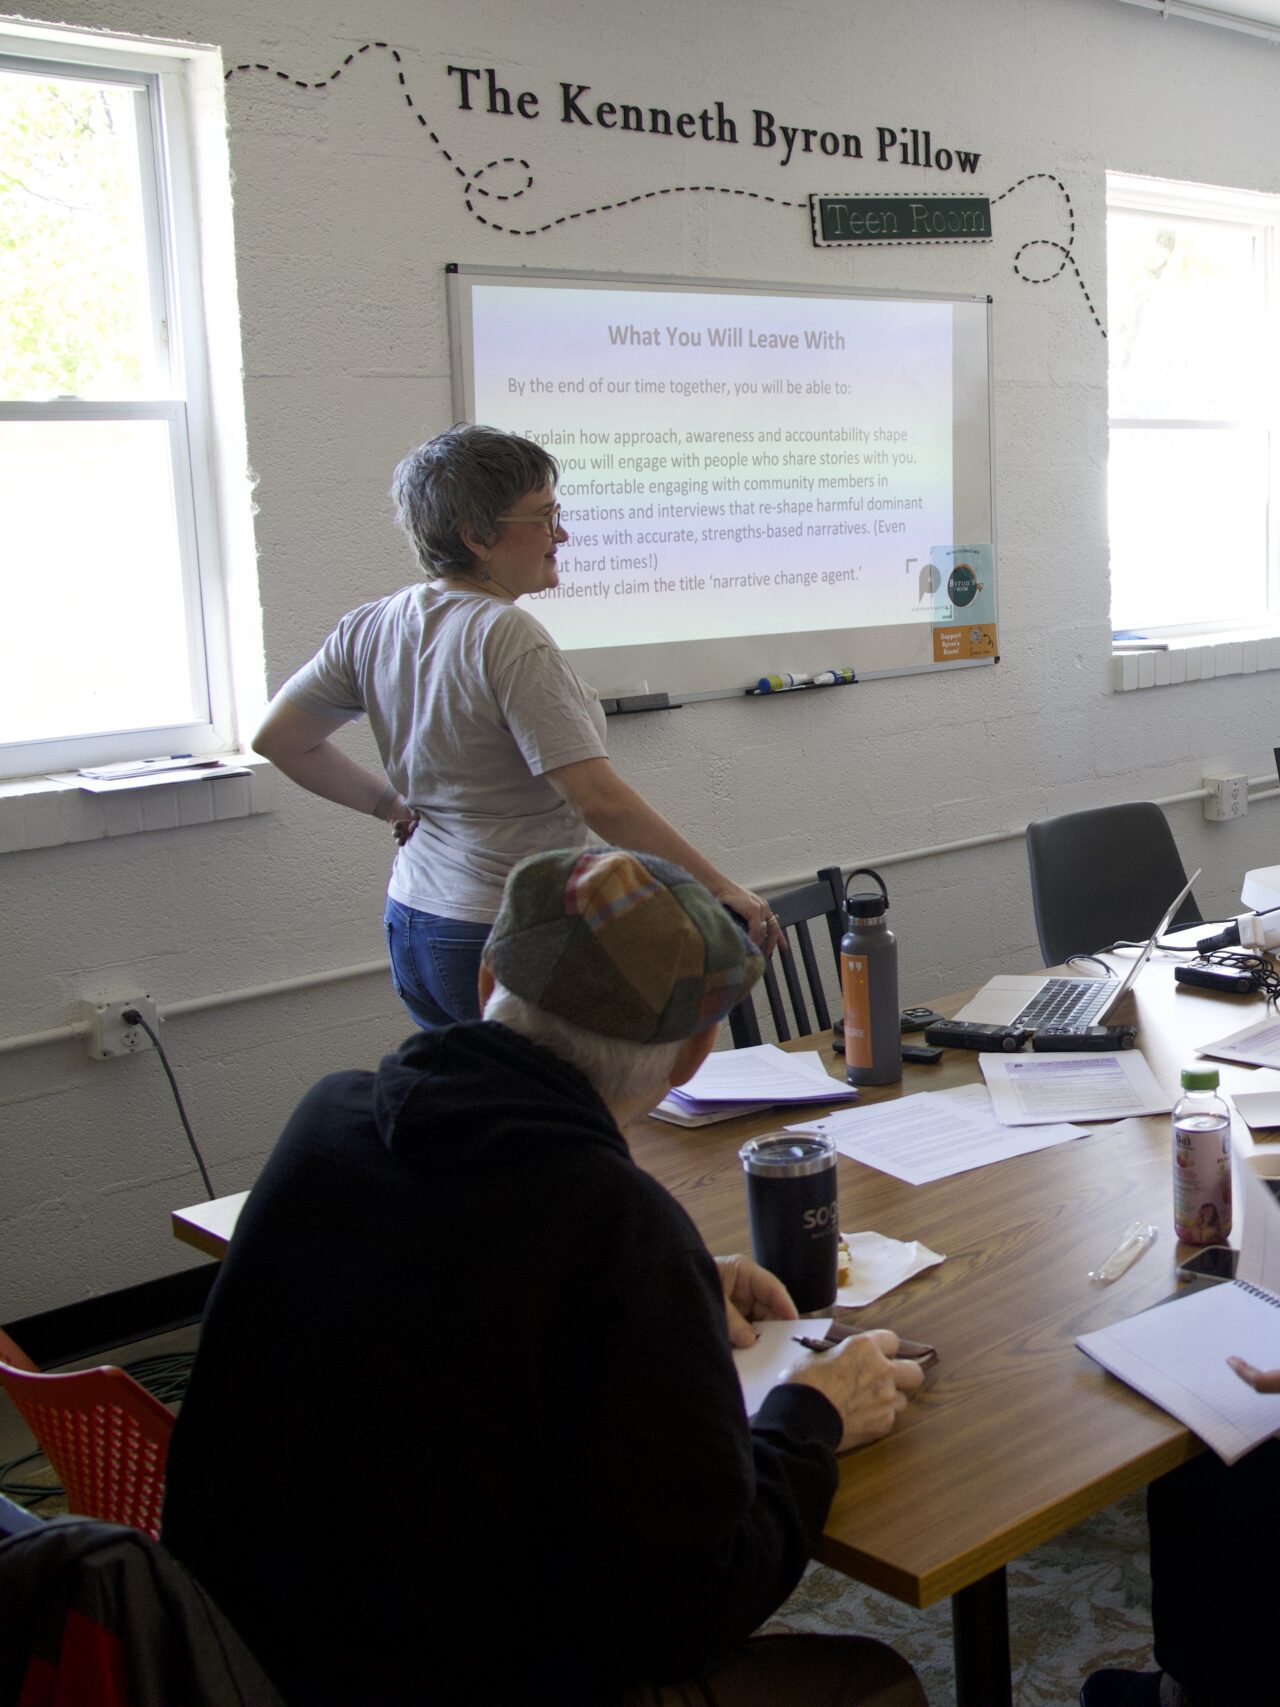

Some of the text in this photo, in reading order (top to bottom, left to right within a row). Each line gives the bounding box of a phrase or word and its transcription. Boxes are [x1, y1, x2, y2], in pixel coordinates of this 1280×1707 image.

[448, 65, 982, 174] The Kenneth Byron Pillow
[827, 204, 987, 234] Teen Room
[608, 323, 845, 351] What You Will Leave With
[508, 376, 851, 398] By the end of our time together, you will be able to:
[525, 427, 908, 448] Explain how approach, awareness and accountability shape
[560, 449, 917, 474] you will engage with people who share stories with you.
[560, 473, 889, 497] comfortable engaging with community members in
[561, 496, 923, 522] ersations and interviews that re-shape harmful dominant
[602, 528, 632, 545] with
[637, 528, 698, 544] accurate,
[701, 521, 803, 543] strengths-based
[807, 521, 870, 536] narratives.
[874, 519, 906, 537] (Even
[574, 556, 606, 572] hard
[610, 552, 658, 571] times!)
[614, 578, 650, 596] claim
[653, 576, 676, 593] the
[679, 574, 705, 591] title
[774, 569, 818, 587] change
